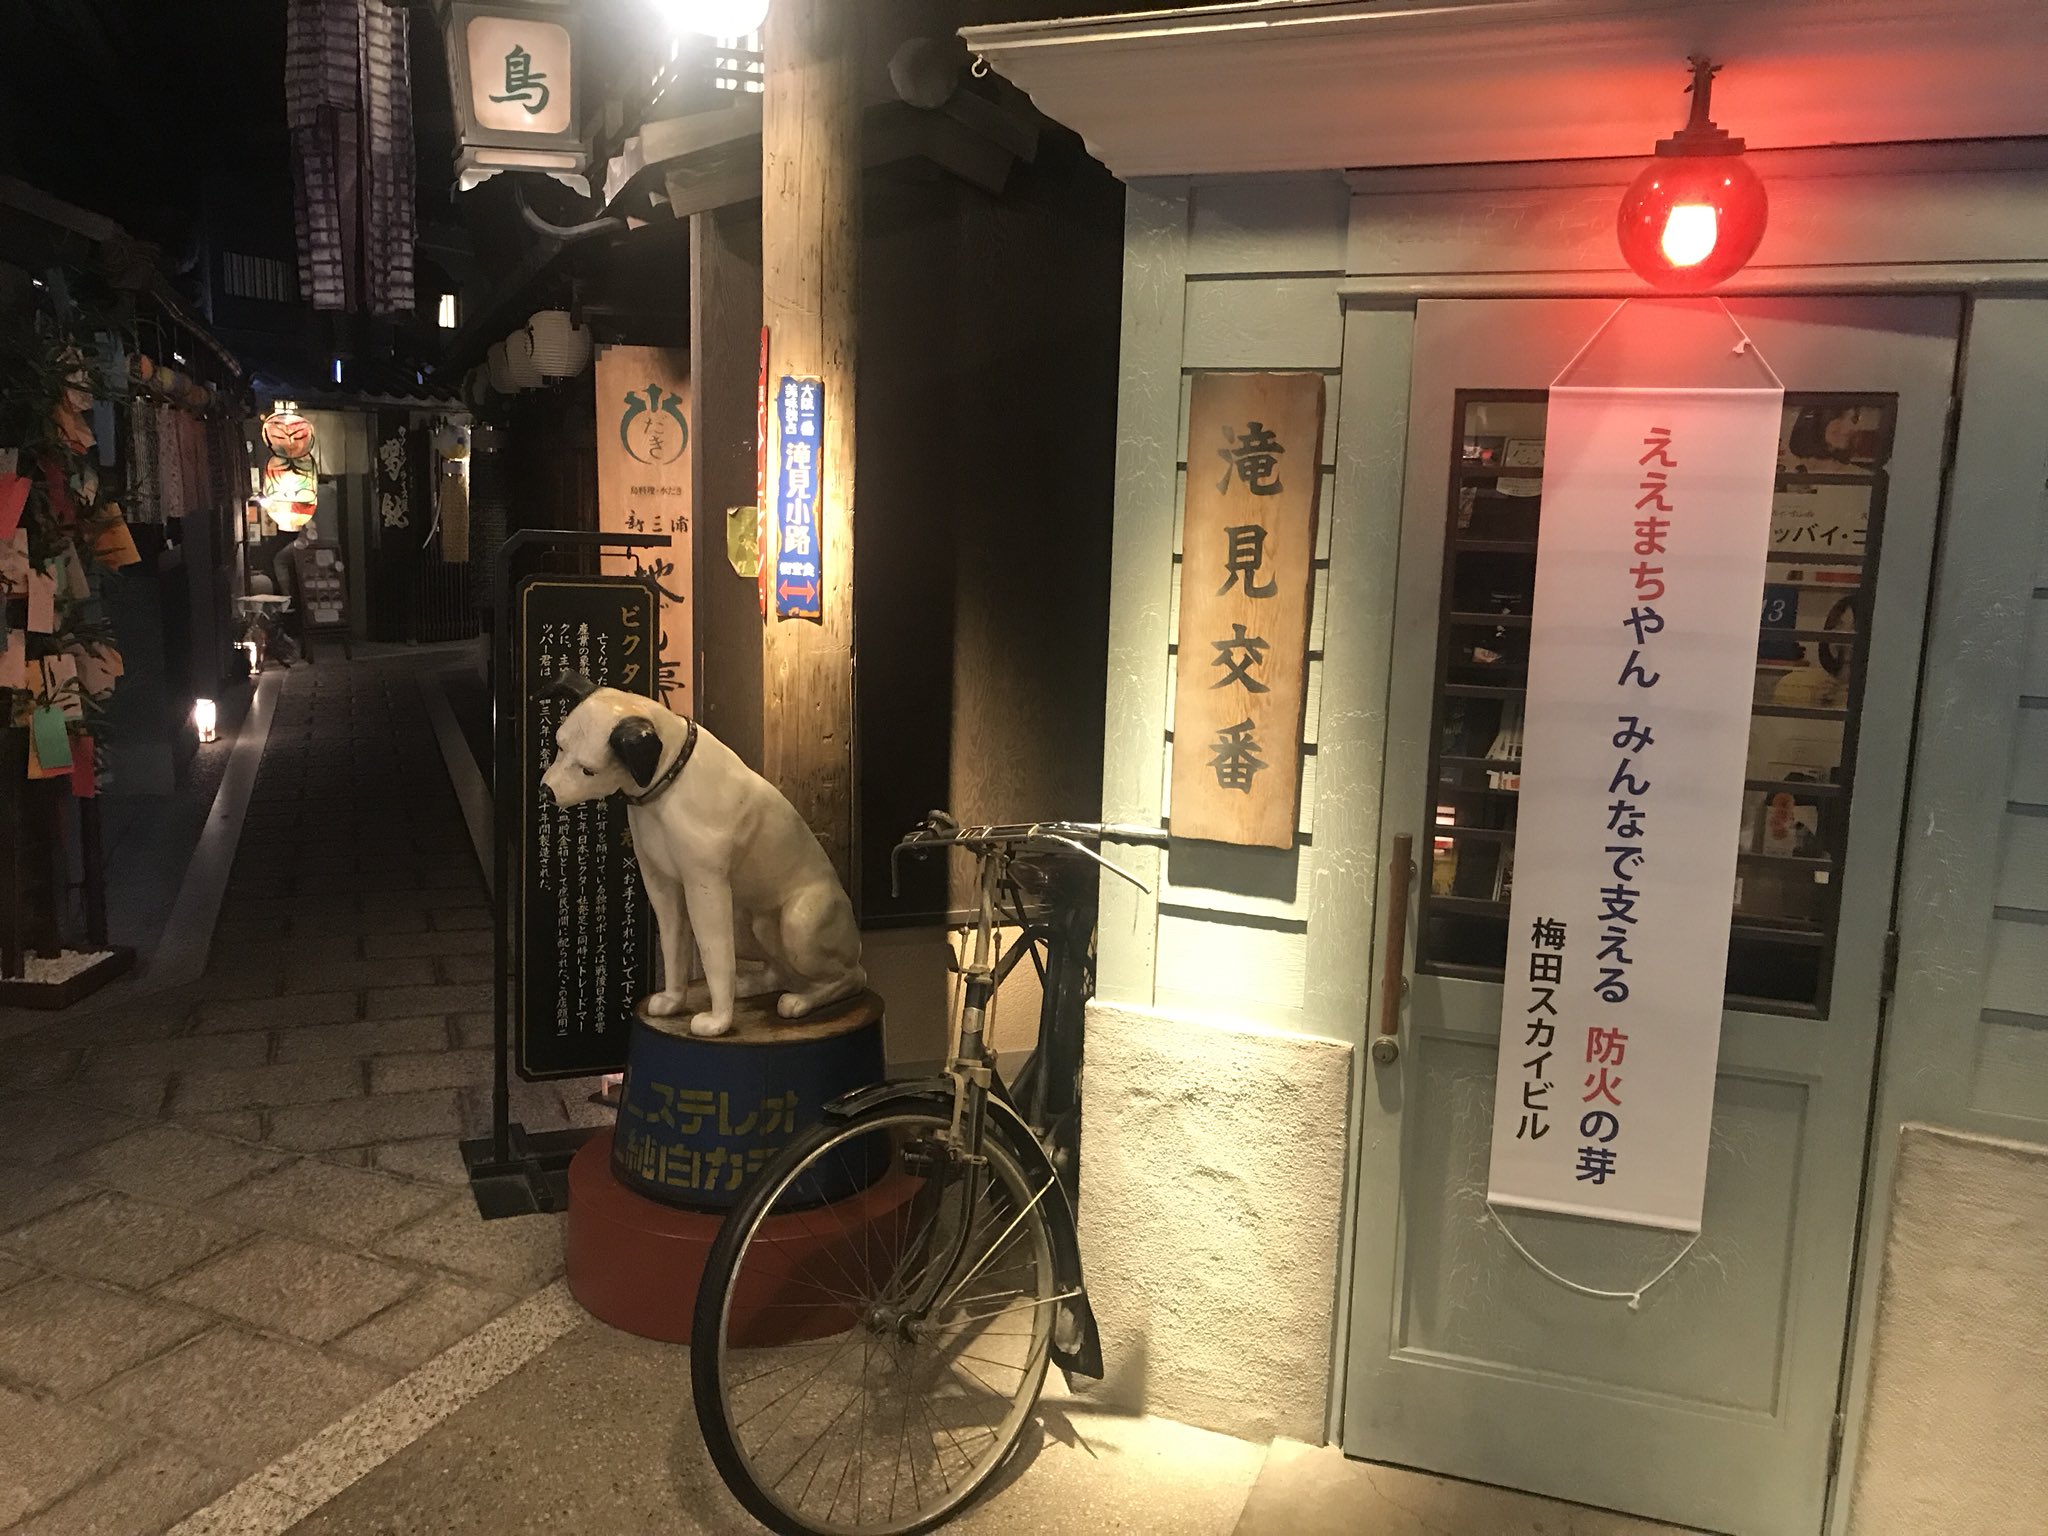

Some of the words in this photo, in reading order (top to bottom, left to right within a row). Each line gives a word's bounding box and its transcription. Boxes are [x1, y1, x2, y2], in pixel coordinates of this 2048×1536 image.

[489, 44, 549, 114] 鳥
[784, 441, 811, 556] 滝見小路
[1206, 421, 1286, 794] 滝見交番
[1593, 715, 1656, 1004] みんなで支える
[1516, 917, 1567, 1141] 梅田スカイビル
[1575, 1026, 1629, 1185] 防火の芽
